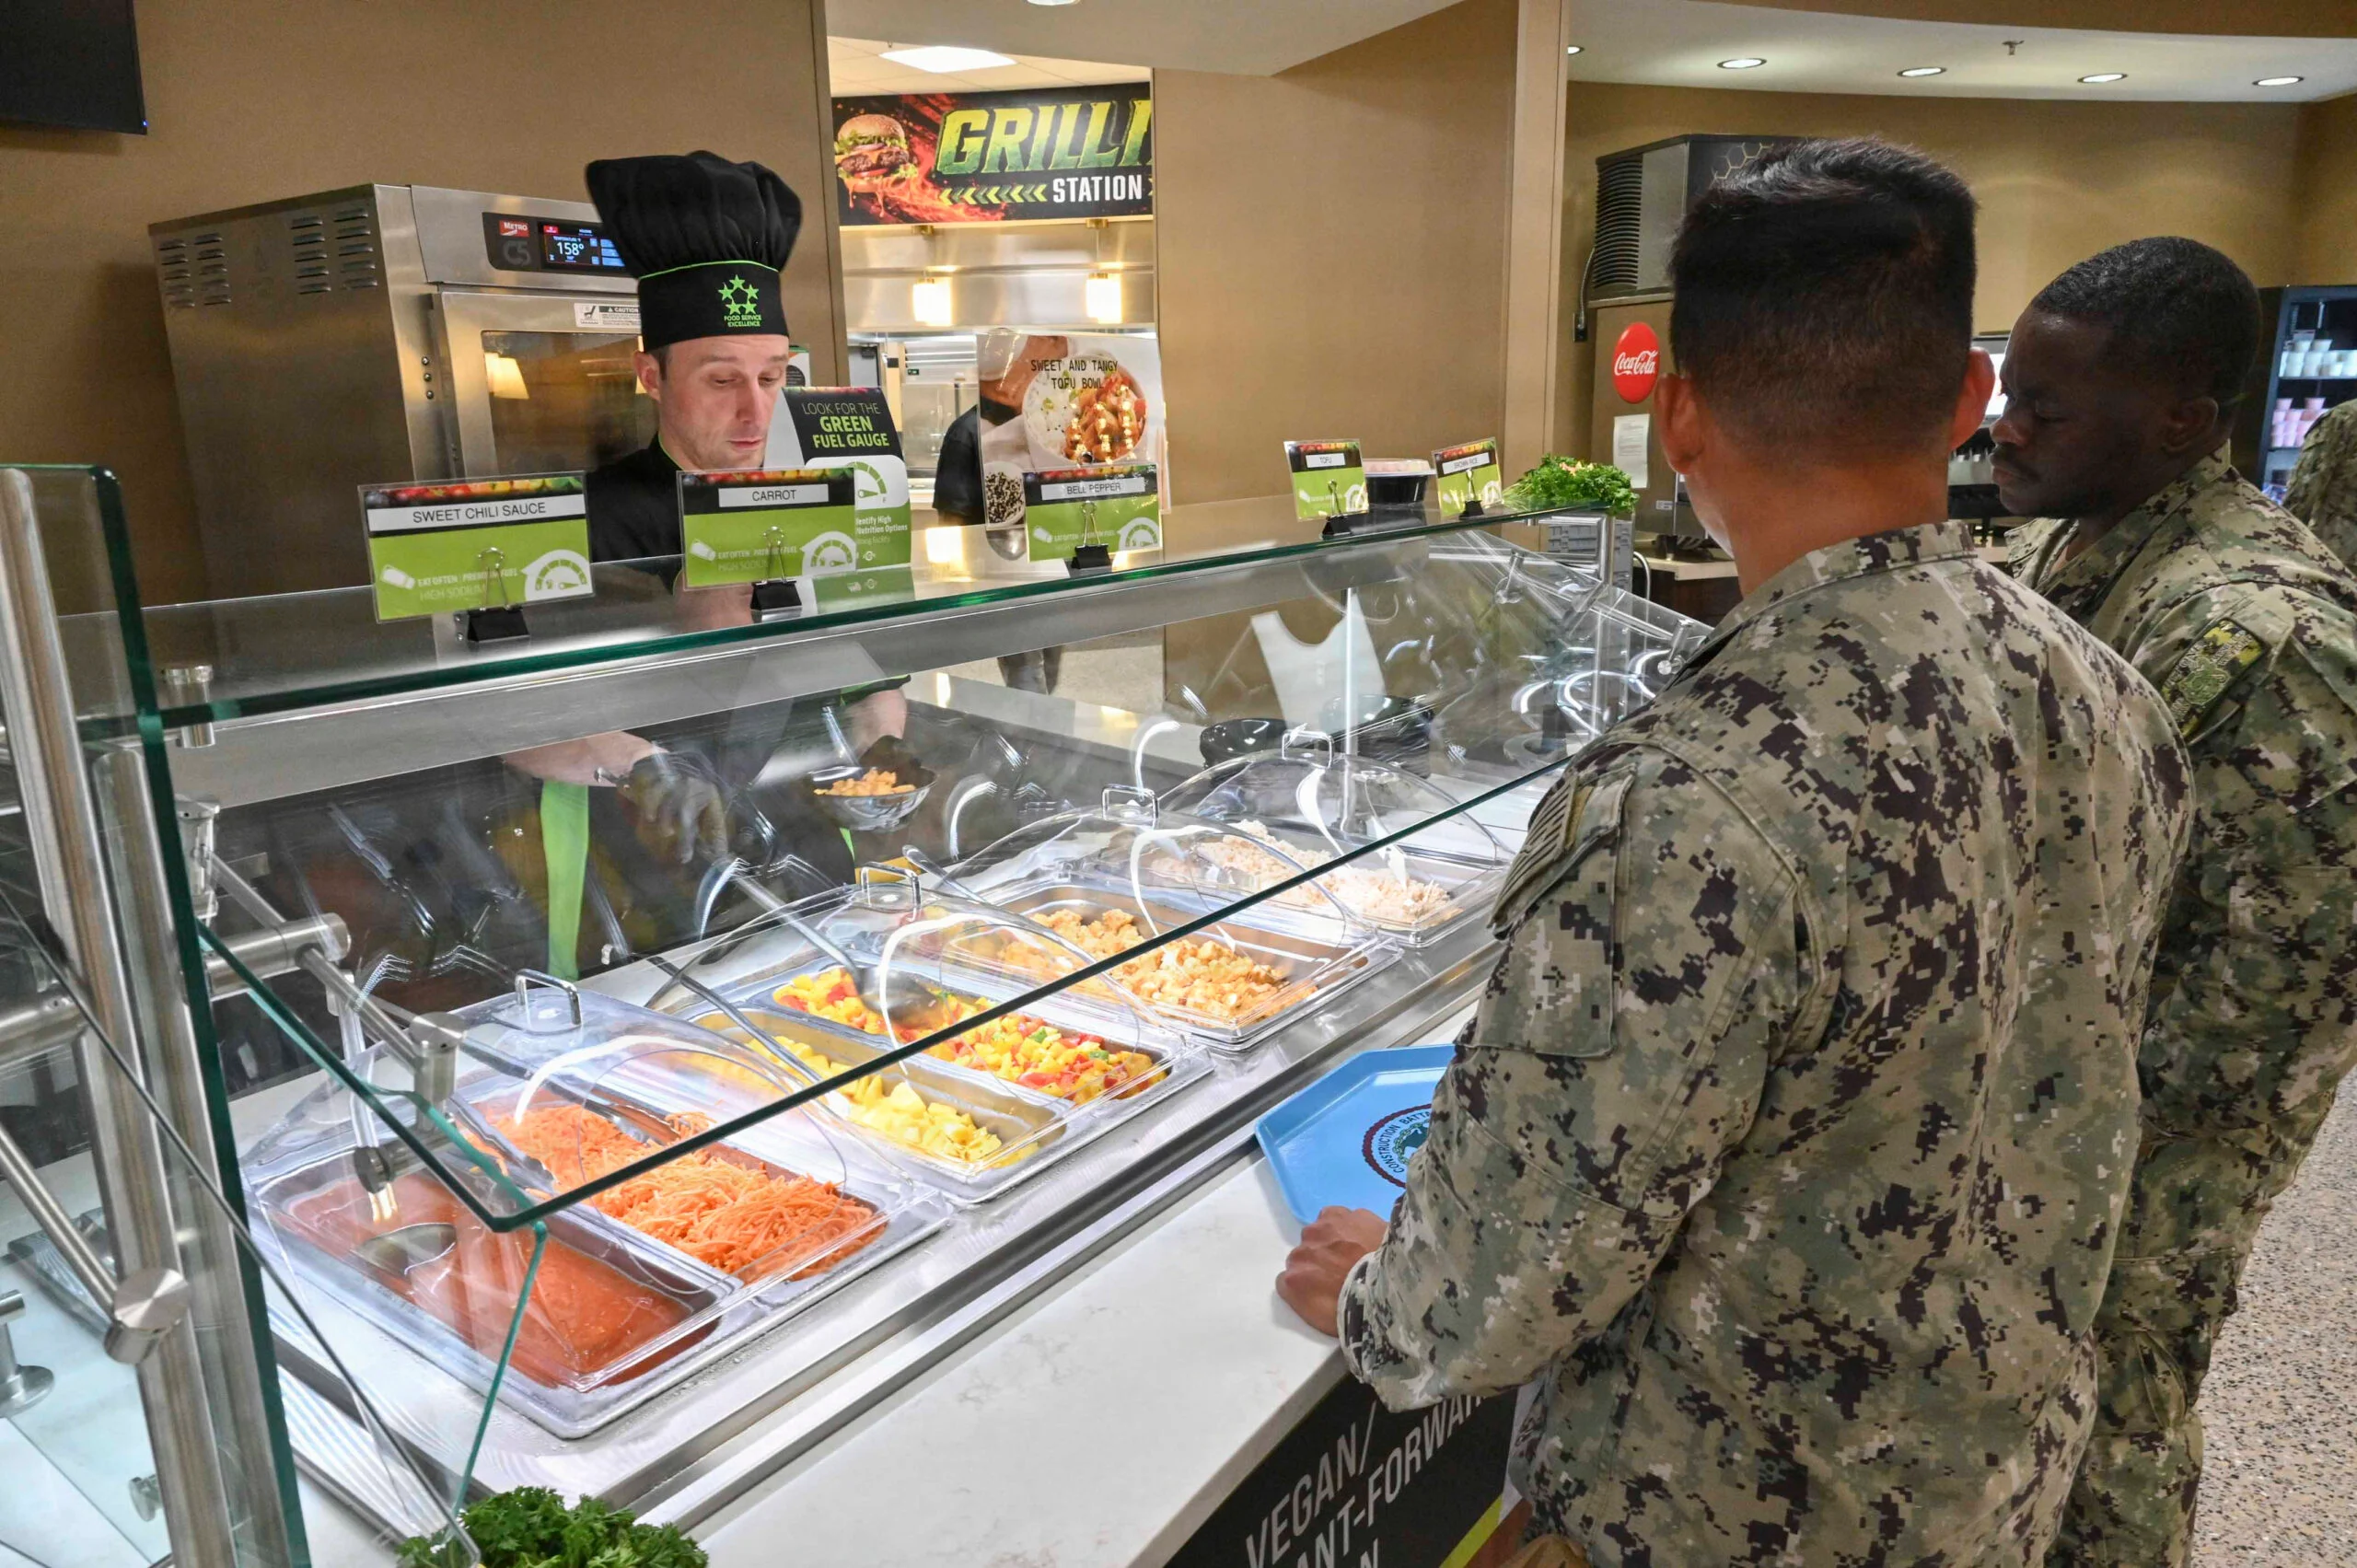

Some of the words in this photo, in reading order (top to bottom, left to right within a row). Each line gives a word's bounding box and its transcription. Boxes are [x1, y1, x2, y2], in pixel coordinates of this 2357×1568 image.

[1052, 174, 1143, 203] STATION
[503, 221, 528, 231] METRO
[503, 239, 531, 265] C5
[1030, 359, 1062, 372] SWEET
[1069, 359, 1086, 372] AND
[1091, 359, 1119, 372] TANGY
[1051, 377, 1076, 389] TOFU
[1081, 377, 1105, 389] BOWL
[801, 402, 834, 415] LOOK
[835, 402, 858, 415] FOR
[857, 402, 881, 414] THE
[819, 415, 874, 433] GREEN
[812, 434, 846, 448] FUEL
[846, 433, 890, 447] GAUGE
[1066, 484, 1087, 495] BELL
[1088, 482, 1121, 494] PEPPER
[751, 489, 797, 502] CARROT
[412, 508, 461, 524] SWEET
[465, 507, 499, 519] CHILI
[502, 502, 547, 517] SAUCE
[877, 516, 892, 524] High
[885, 524, 909, 533] Options
[417, 578, 432, 587] EAT
[432, 575, 459, 586] OFTEN
[1377, 1124, 1405, 1174] CONSTRUCTION
[1246, 1400, 1378, 1568] VEGAN/
